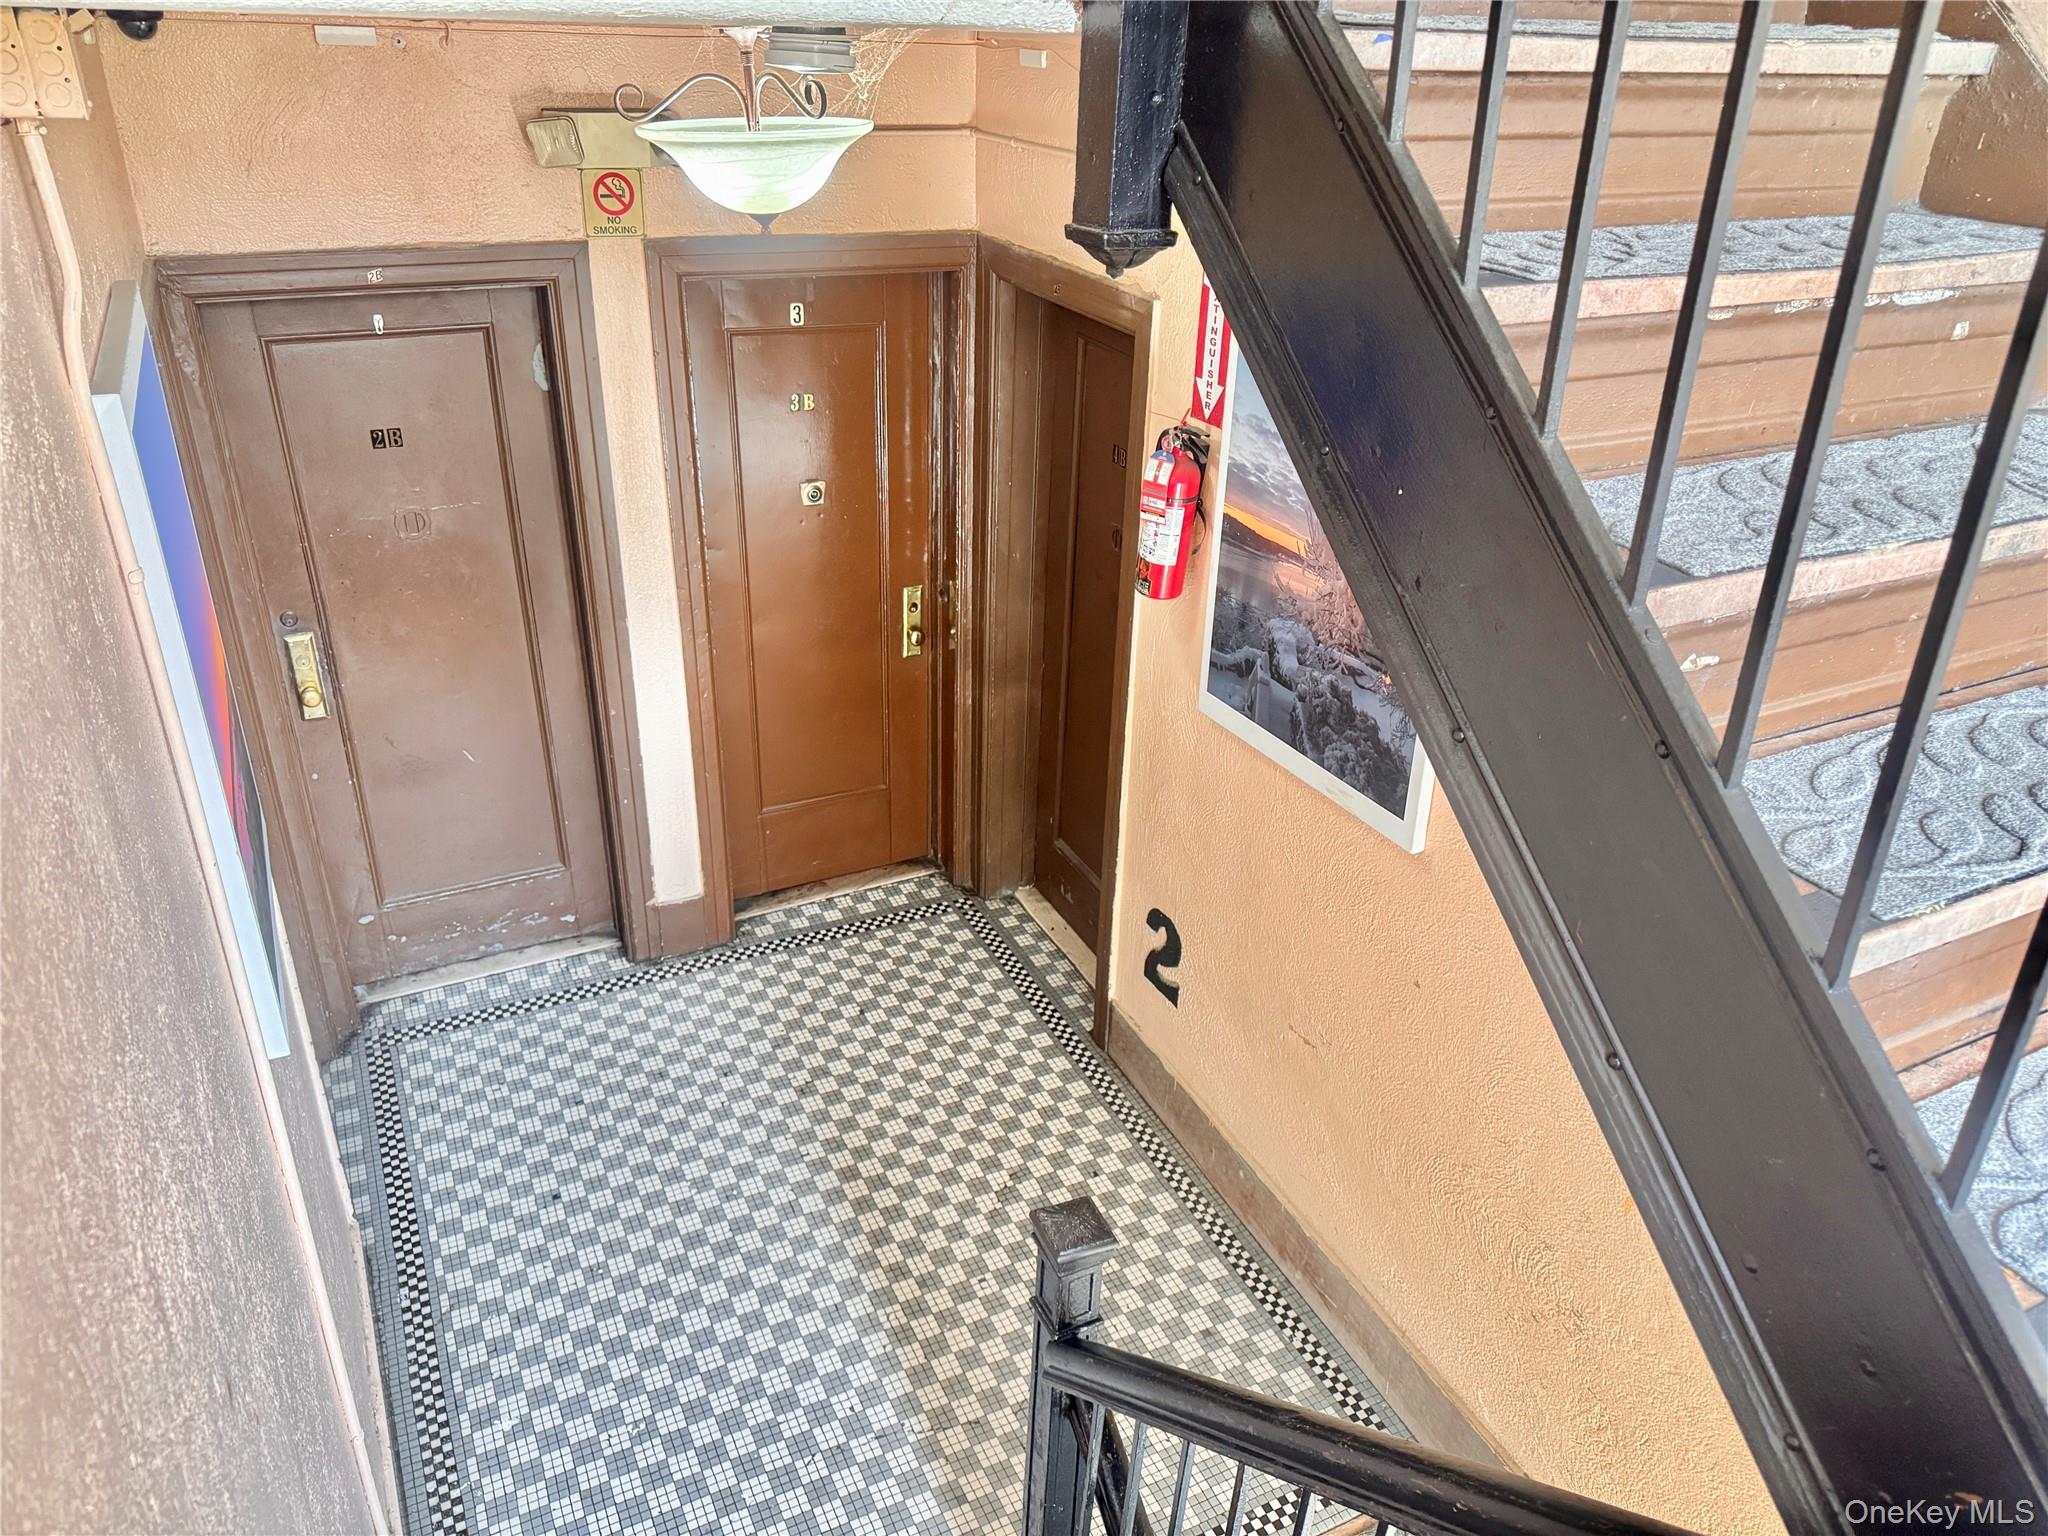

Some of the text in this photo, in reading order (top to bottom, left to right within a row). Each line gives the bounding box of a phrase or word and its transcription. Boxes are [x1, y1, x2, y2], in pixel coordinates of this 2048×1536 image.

[593, 225, 637, 234] SMOKING
[608, 216, 621, 224] NO
[368, 270, 383, 282] 2B
[792, 304, 802, 324] 3
[1205, 297, 1219, 411] TINGUISHER
[371, 428, 403, 449] 2B
[1144, 908, 1181, 1008] 2
